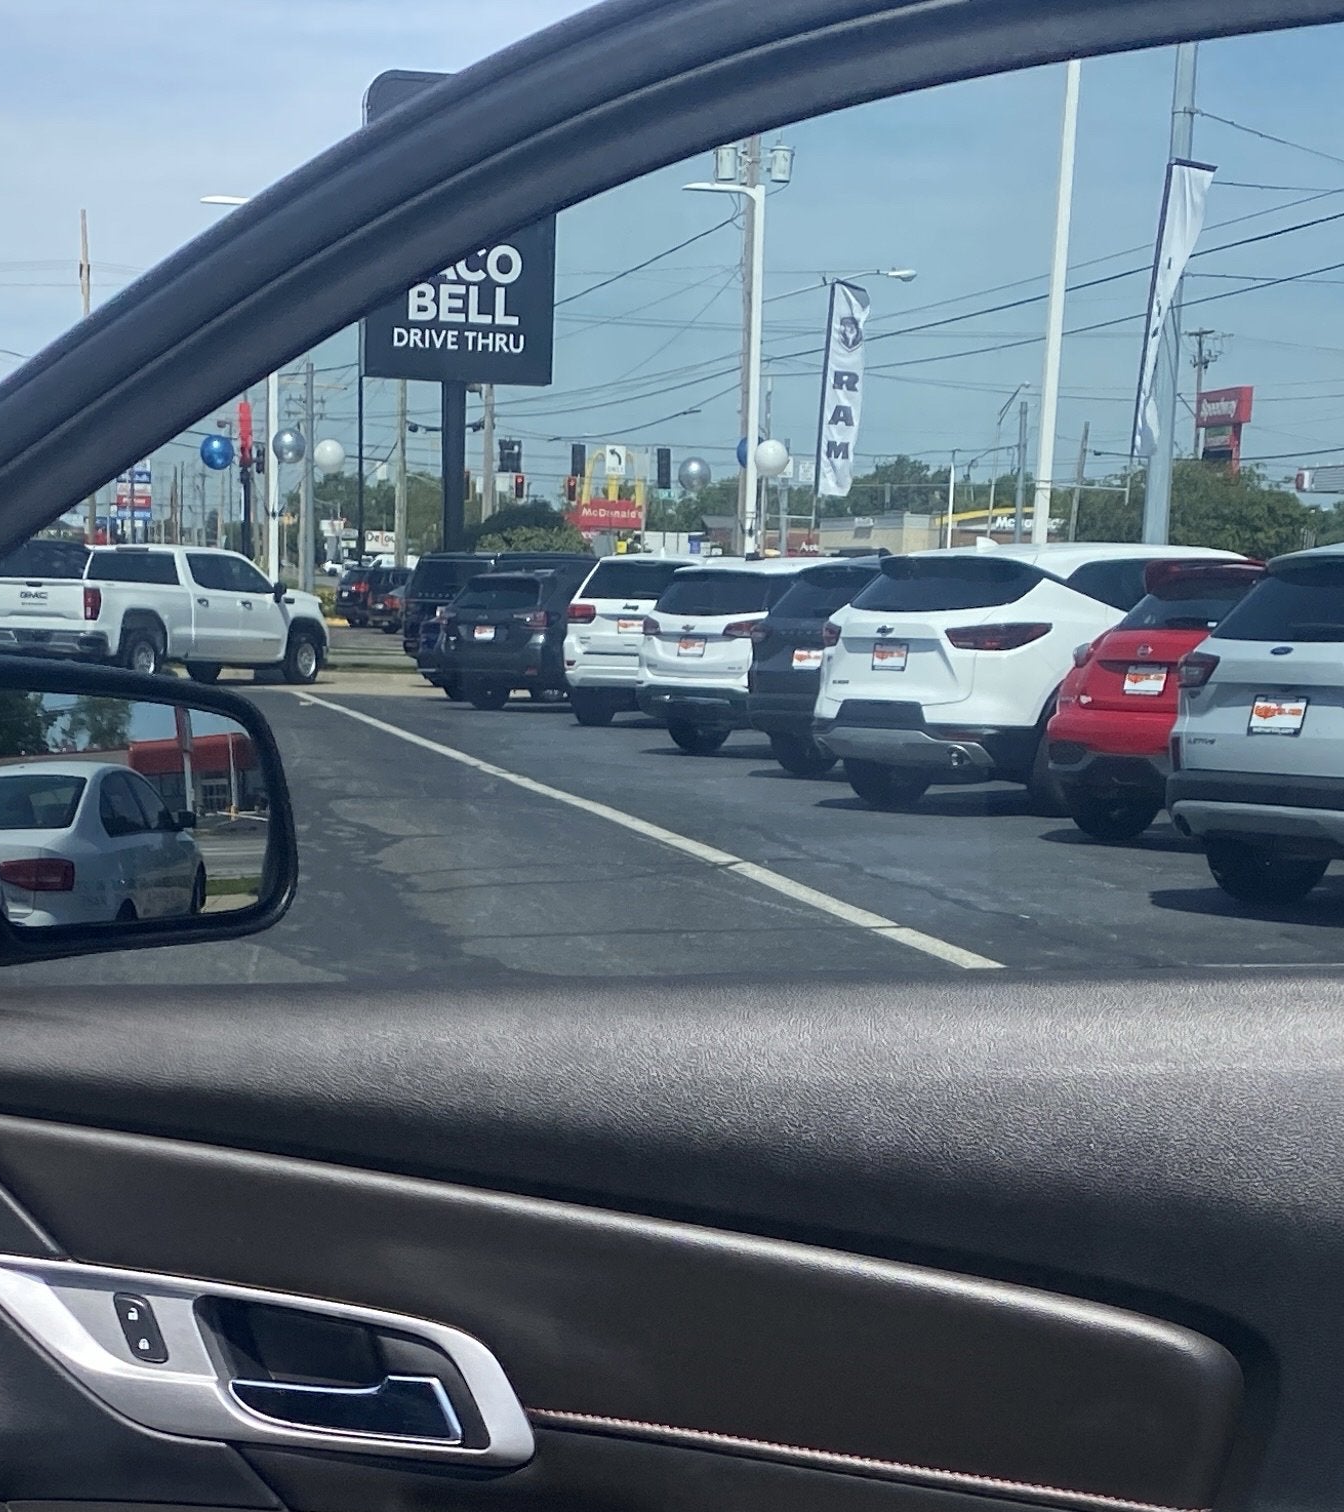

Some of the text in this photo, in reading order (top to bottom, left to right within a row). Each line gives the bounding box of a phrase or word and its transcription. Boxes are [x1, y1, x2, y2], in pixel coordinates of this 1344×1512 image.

[432, 244, 523, 284] CO
[408, 282, 520, 326] BELL
[392, 327, 525, 354] DRIVE THRU
[825, 370, 861, 460] RAM
